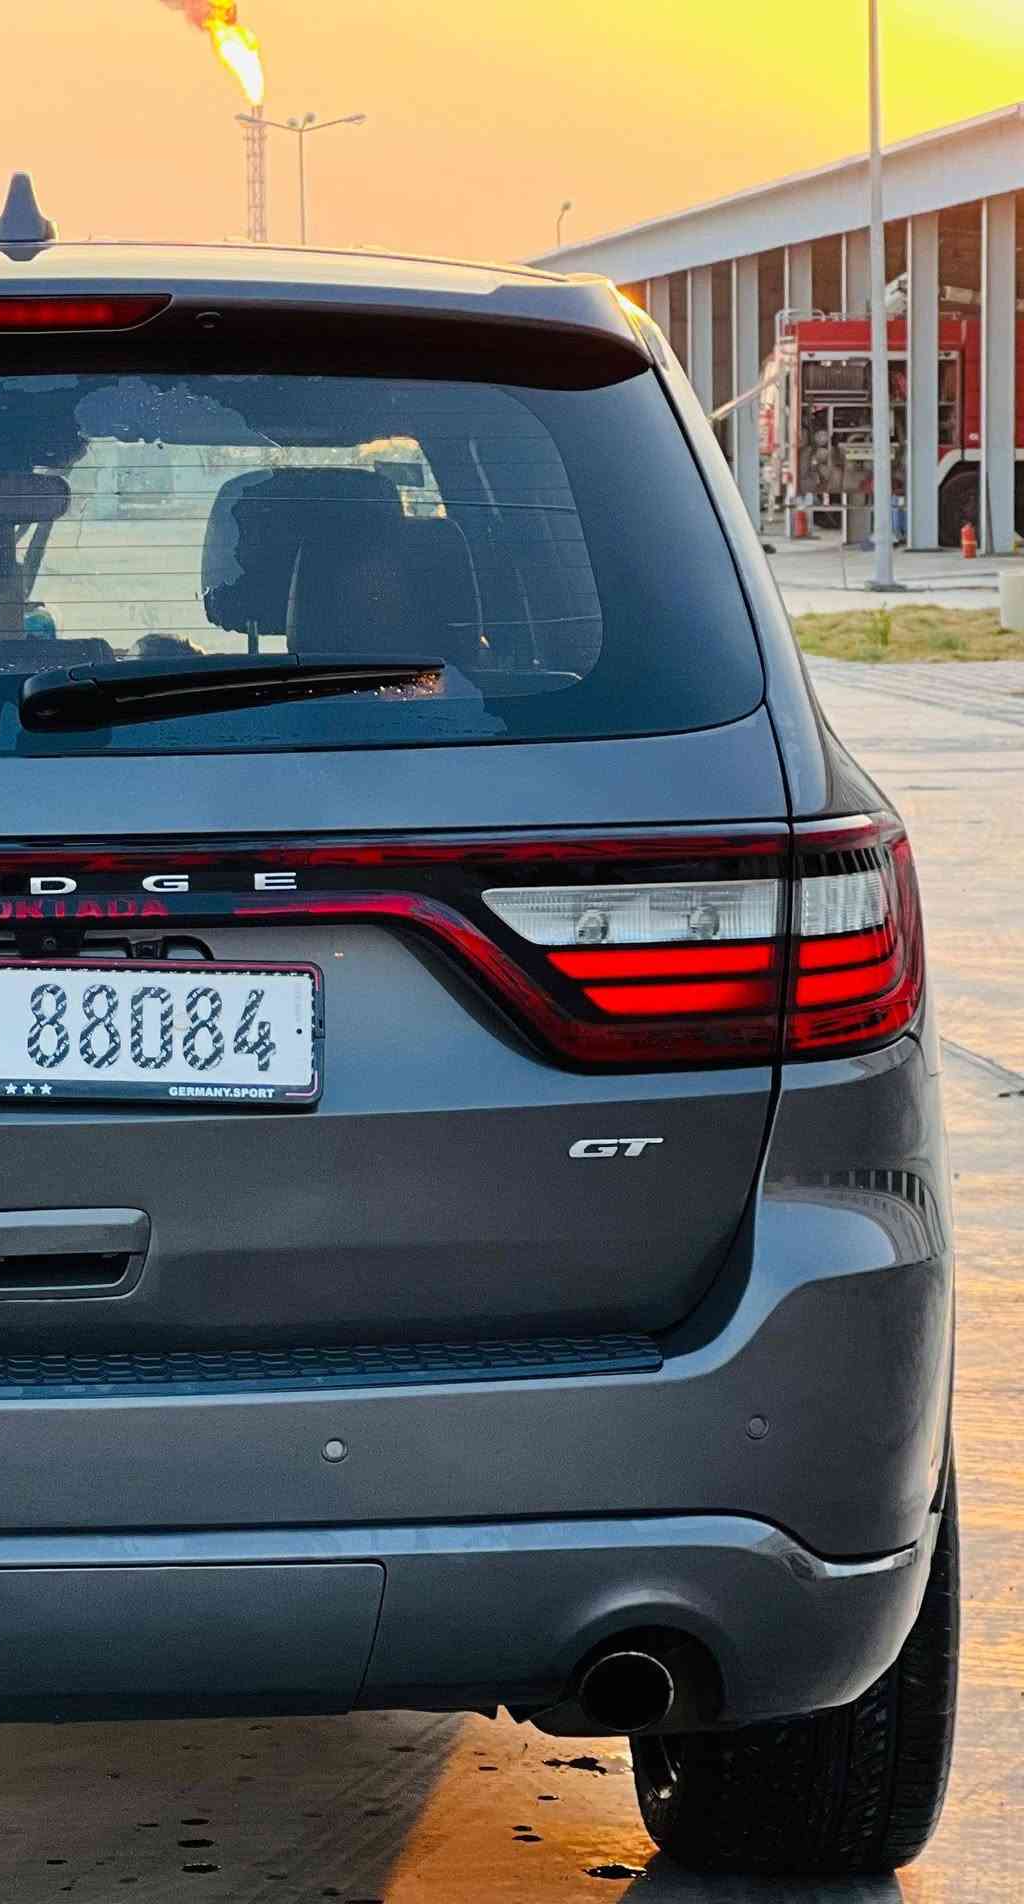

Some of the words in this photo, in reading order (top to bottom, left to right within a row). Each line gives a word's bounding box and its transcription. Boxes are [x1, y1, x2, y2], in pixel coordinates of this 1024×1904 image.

[27, 984, 275, 1072] 88084
[169, 1086, 275, 1098] GERMANY.SPORT
[568, 1137, 664, 1158] GT
